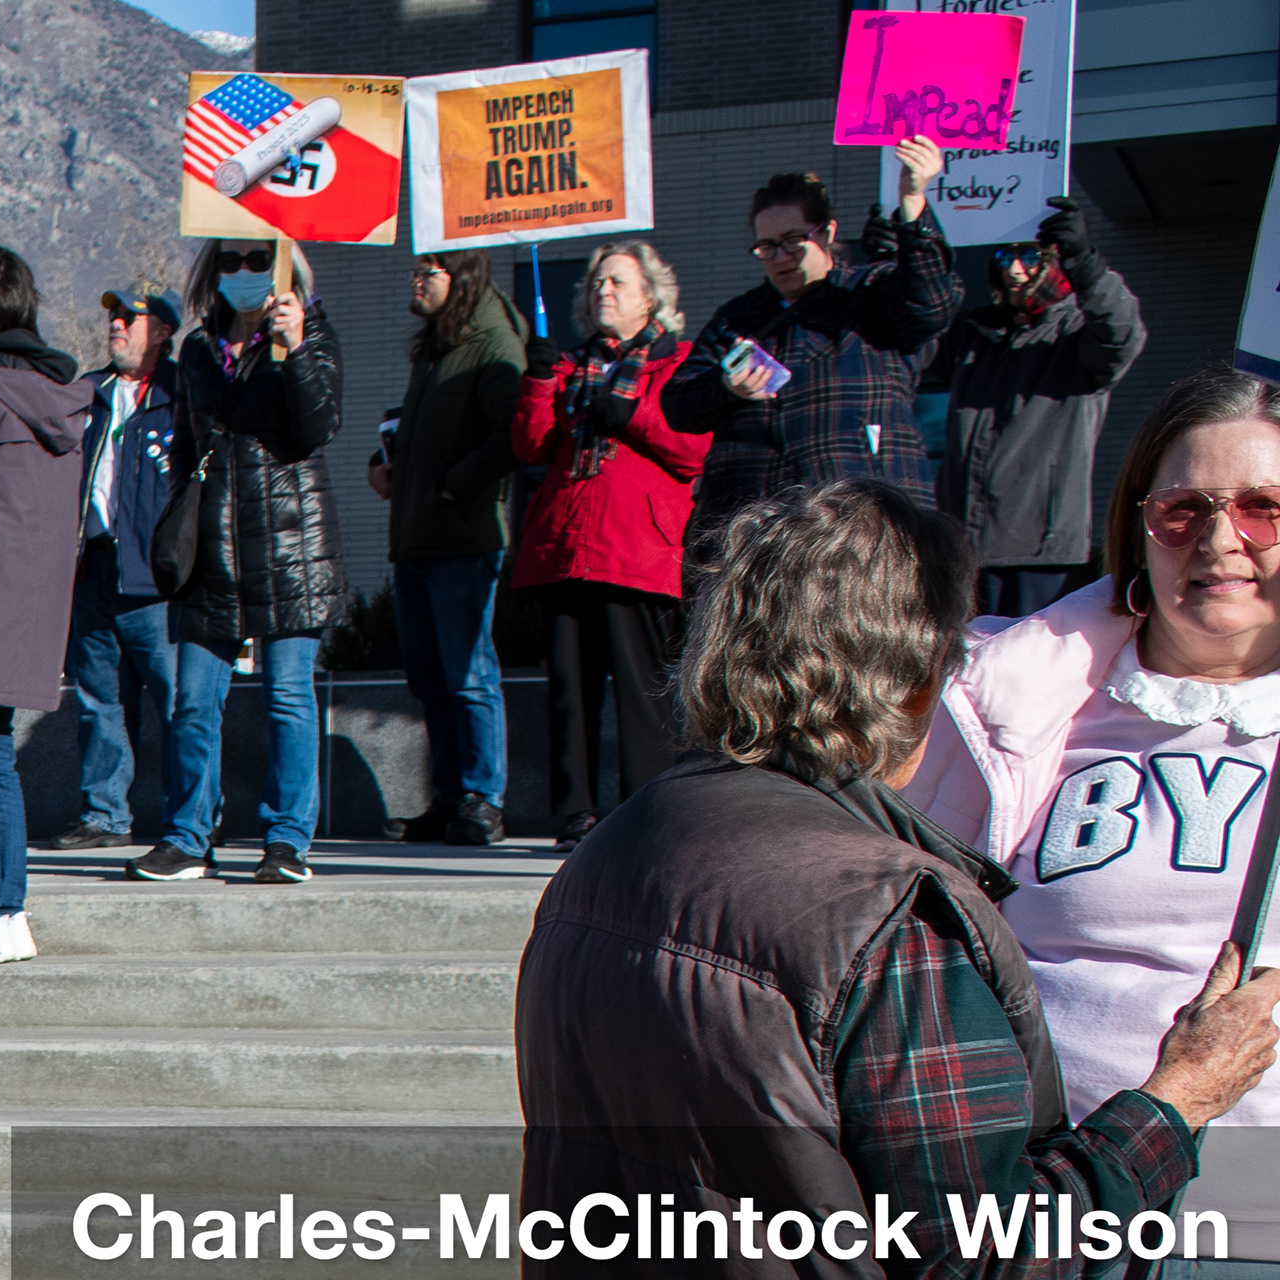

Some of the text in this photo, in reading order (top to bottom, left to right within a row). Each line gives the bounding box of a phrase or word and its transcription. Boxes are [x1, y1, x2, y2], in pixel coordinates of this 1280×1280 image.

[485, 89, 574, 124] IMPEACH
[489, 120, 575, 157] TRUMP.
[484, 155, 588, 200] AGAIN.
[927, 174, 1021, 210] today?
